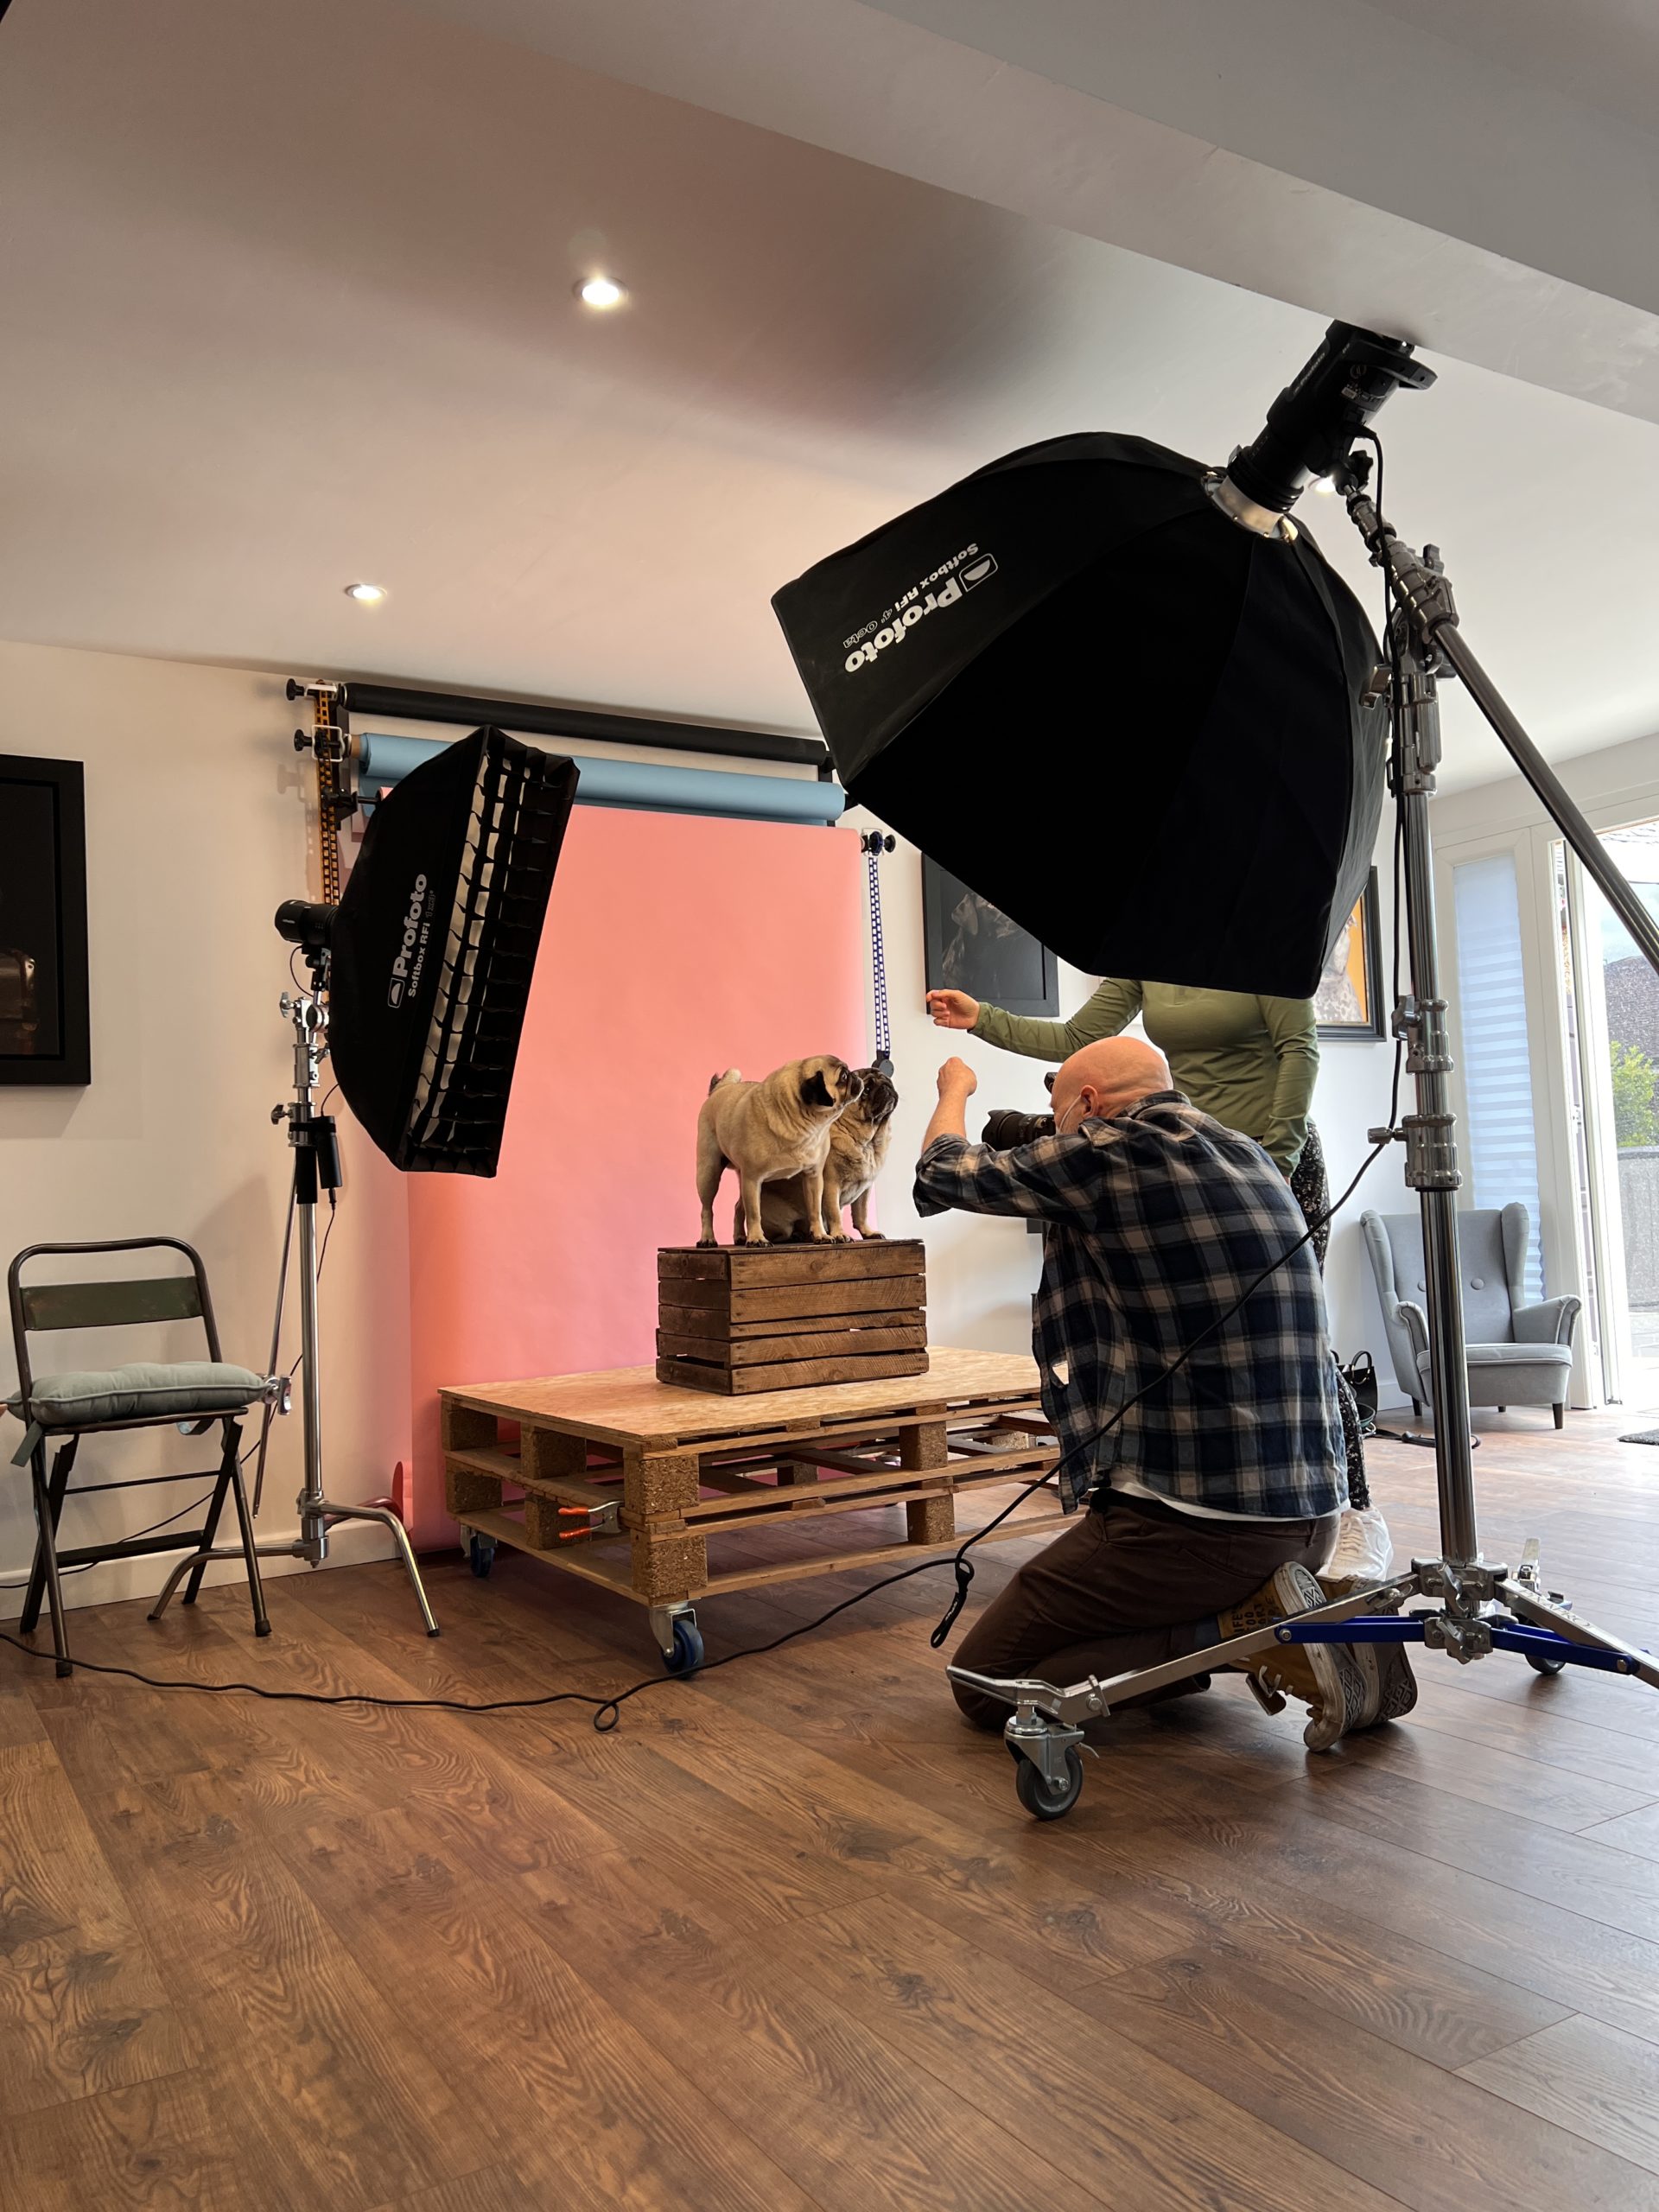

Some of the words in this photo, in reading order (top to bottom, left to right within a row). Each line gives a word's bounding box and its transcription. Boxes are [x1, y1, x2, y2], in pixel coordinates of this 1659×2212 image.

[920, 543, 979, 588] Softbox
[844, 576, 963, 673] Profoto
[895, 587, 919, 612] RFi
[843, 620, 878, 649] Octa
[392, 874, 427, 978] Profoto
[408, 948, 426, 998] Softbox
[419, 923, 431, 944] RFi
